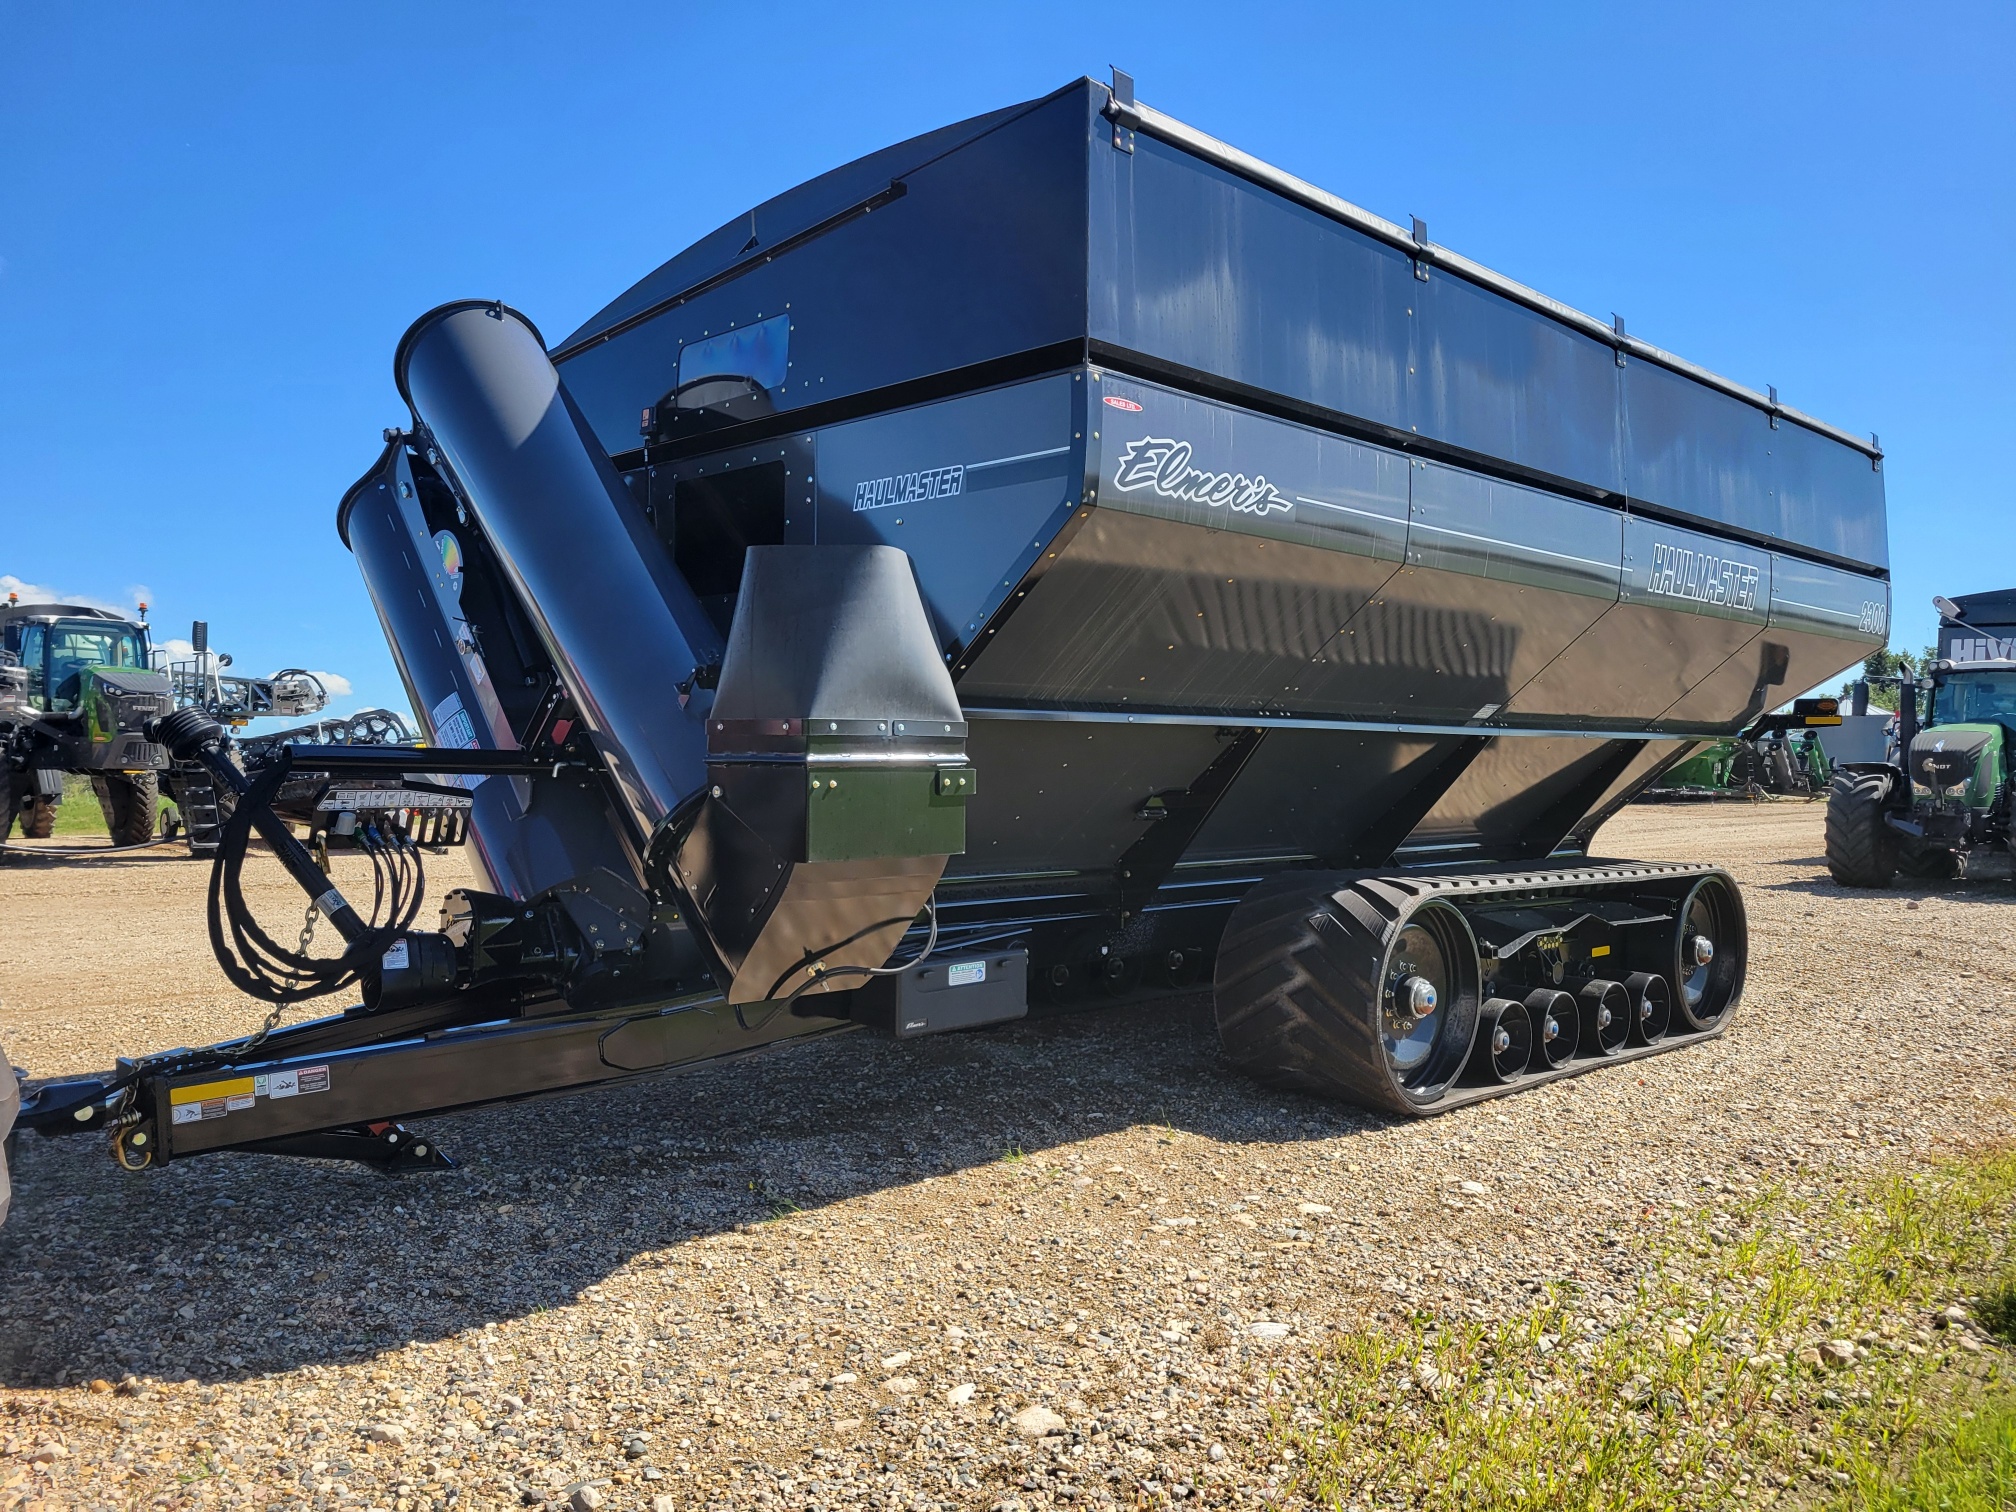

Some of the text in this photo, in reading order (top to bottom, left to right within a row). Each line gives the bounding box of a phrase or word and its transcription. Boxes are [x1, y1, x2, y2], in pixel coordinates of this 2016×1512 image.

[853, 465, 964, 512] HAULMASTER
[1114, 436, 1294, 516] Elmer's
[1647, 543, 1760, 612] HAULMASTER
[1858, 601, 1887, 635] 2300
[303, 1067, 327, 1075] DANGER
